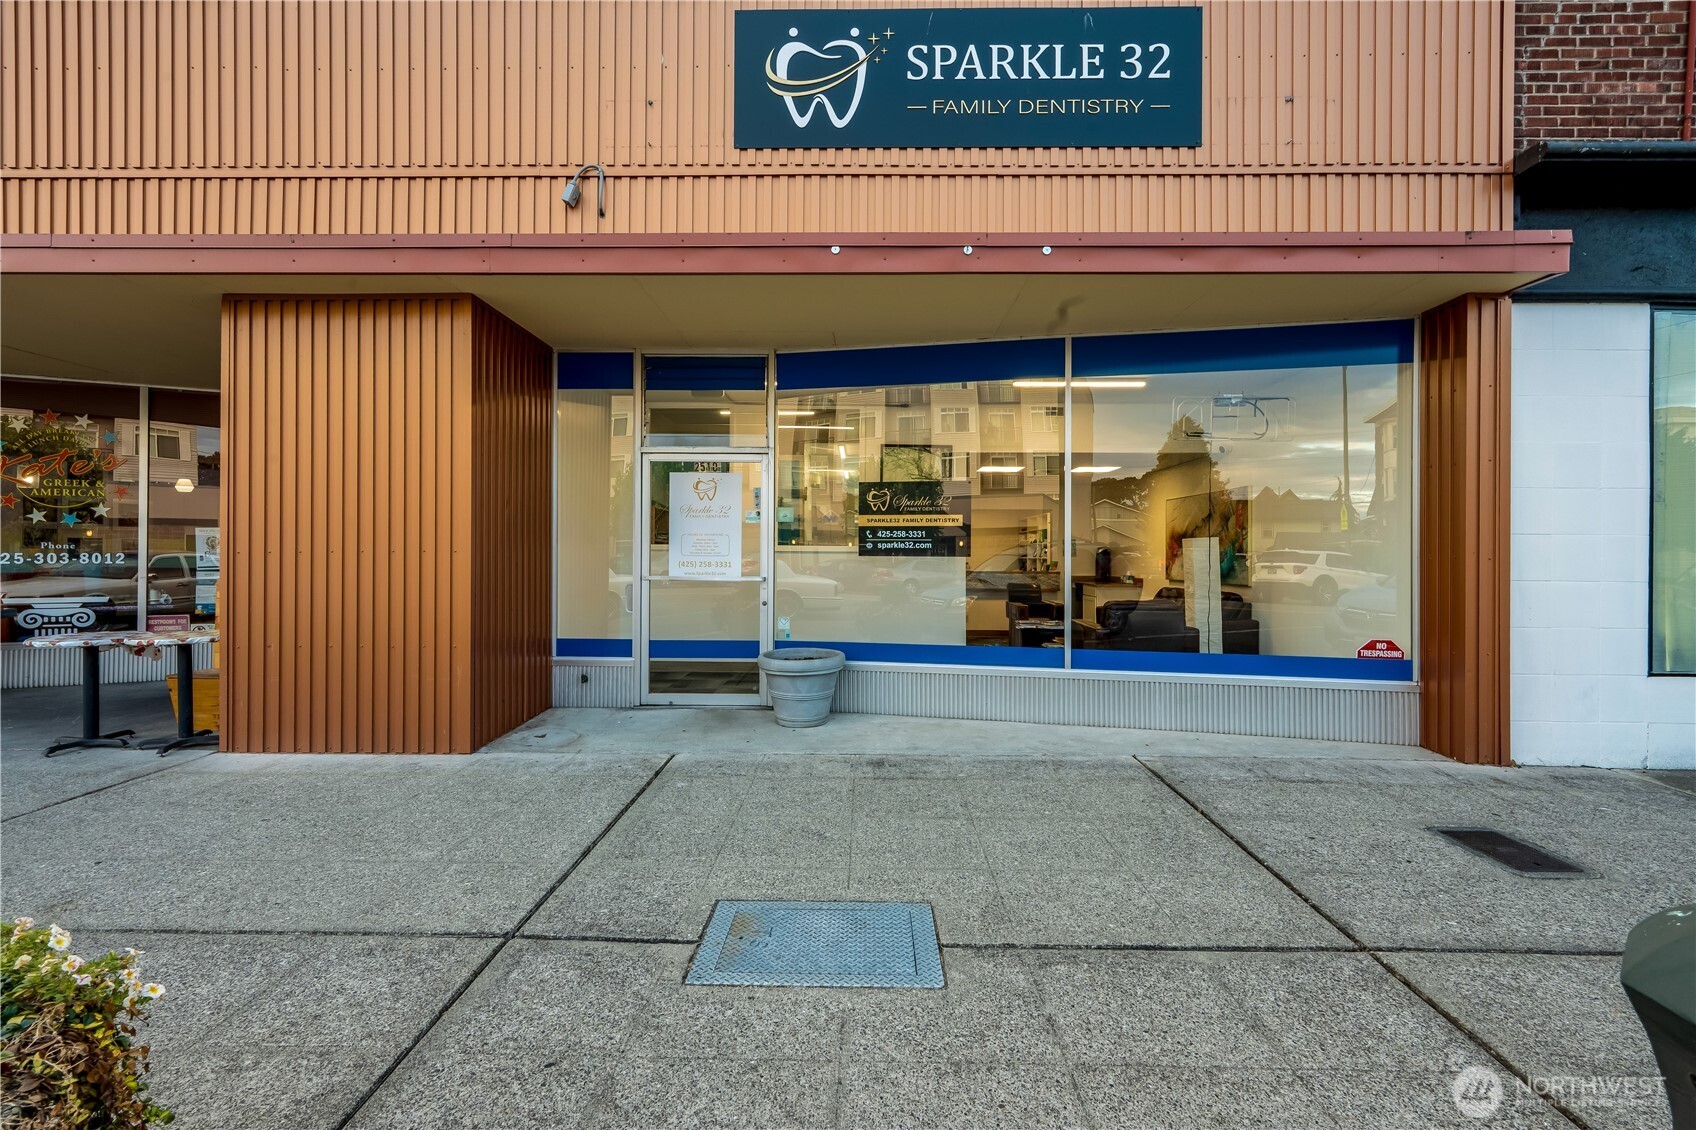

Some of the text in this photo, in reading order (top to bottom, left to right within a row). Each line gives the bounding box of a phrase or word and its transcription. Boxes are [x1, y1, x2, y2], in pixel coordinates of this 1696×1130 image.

[906, 43, 1171, 80] SPARKLE 32
[932, 98, 1144, 115] FAMILY DENTISTRY
[28, 435, 59, 448] LUNCH
[43, 479, 105, 488] GREEK &
[30, 488, 105, 497] AMERICAN
[893, 495, 953, 512] Sparkle 32
[716, 505, 732, 515] 32
[40, 541, 76, 550] Phone
[877, 542, 932, 550] sparkle32.com
[678, 561, 697, 569] (425)
[1360, 650, 1402, 658] TRESPASSING
